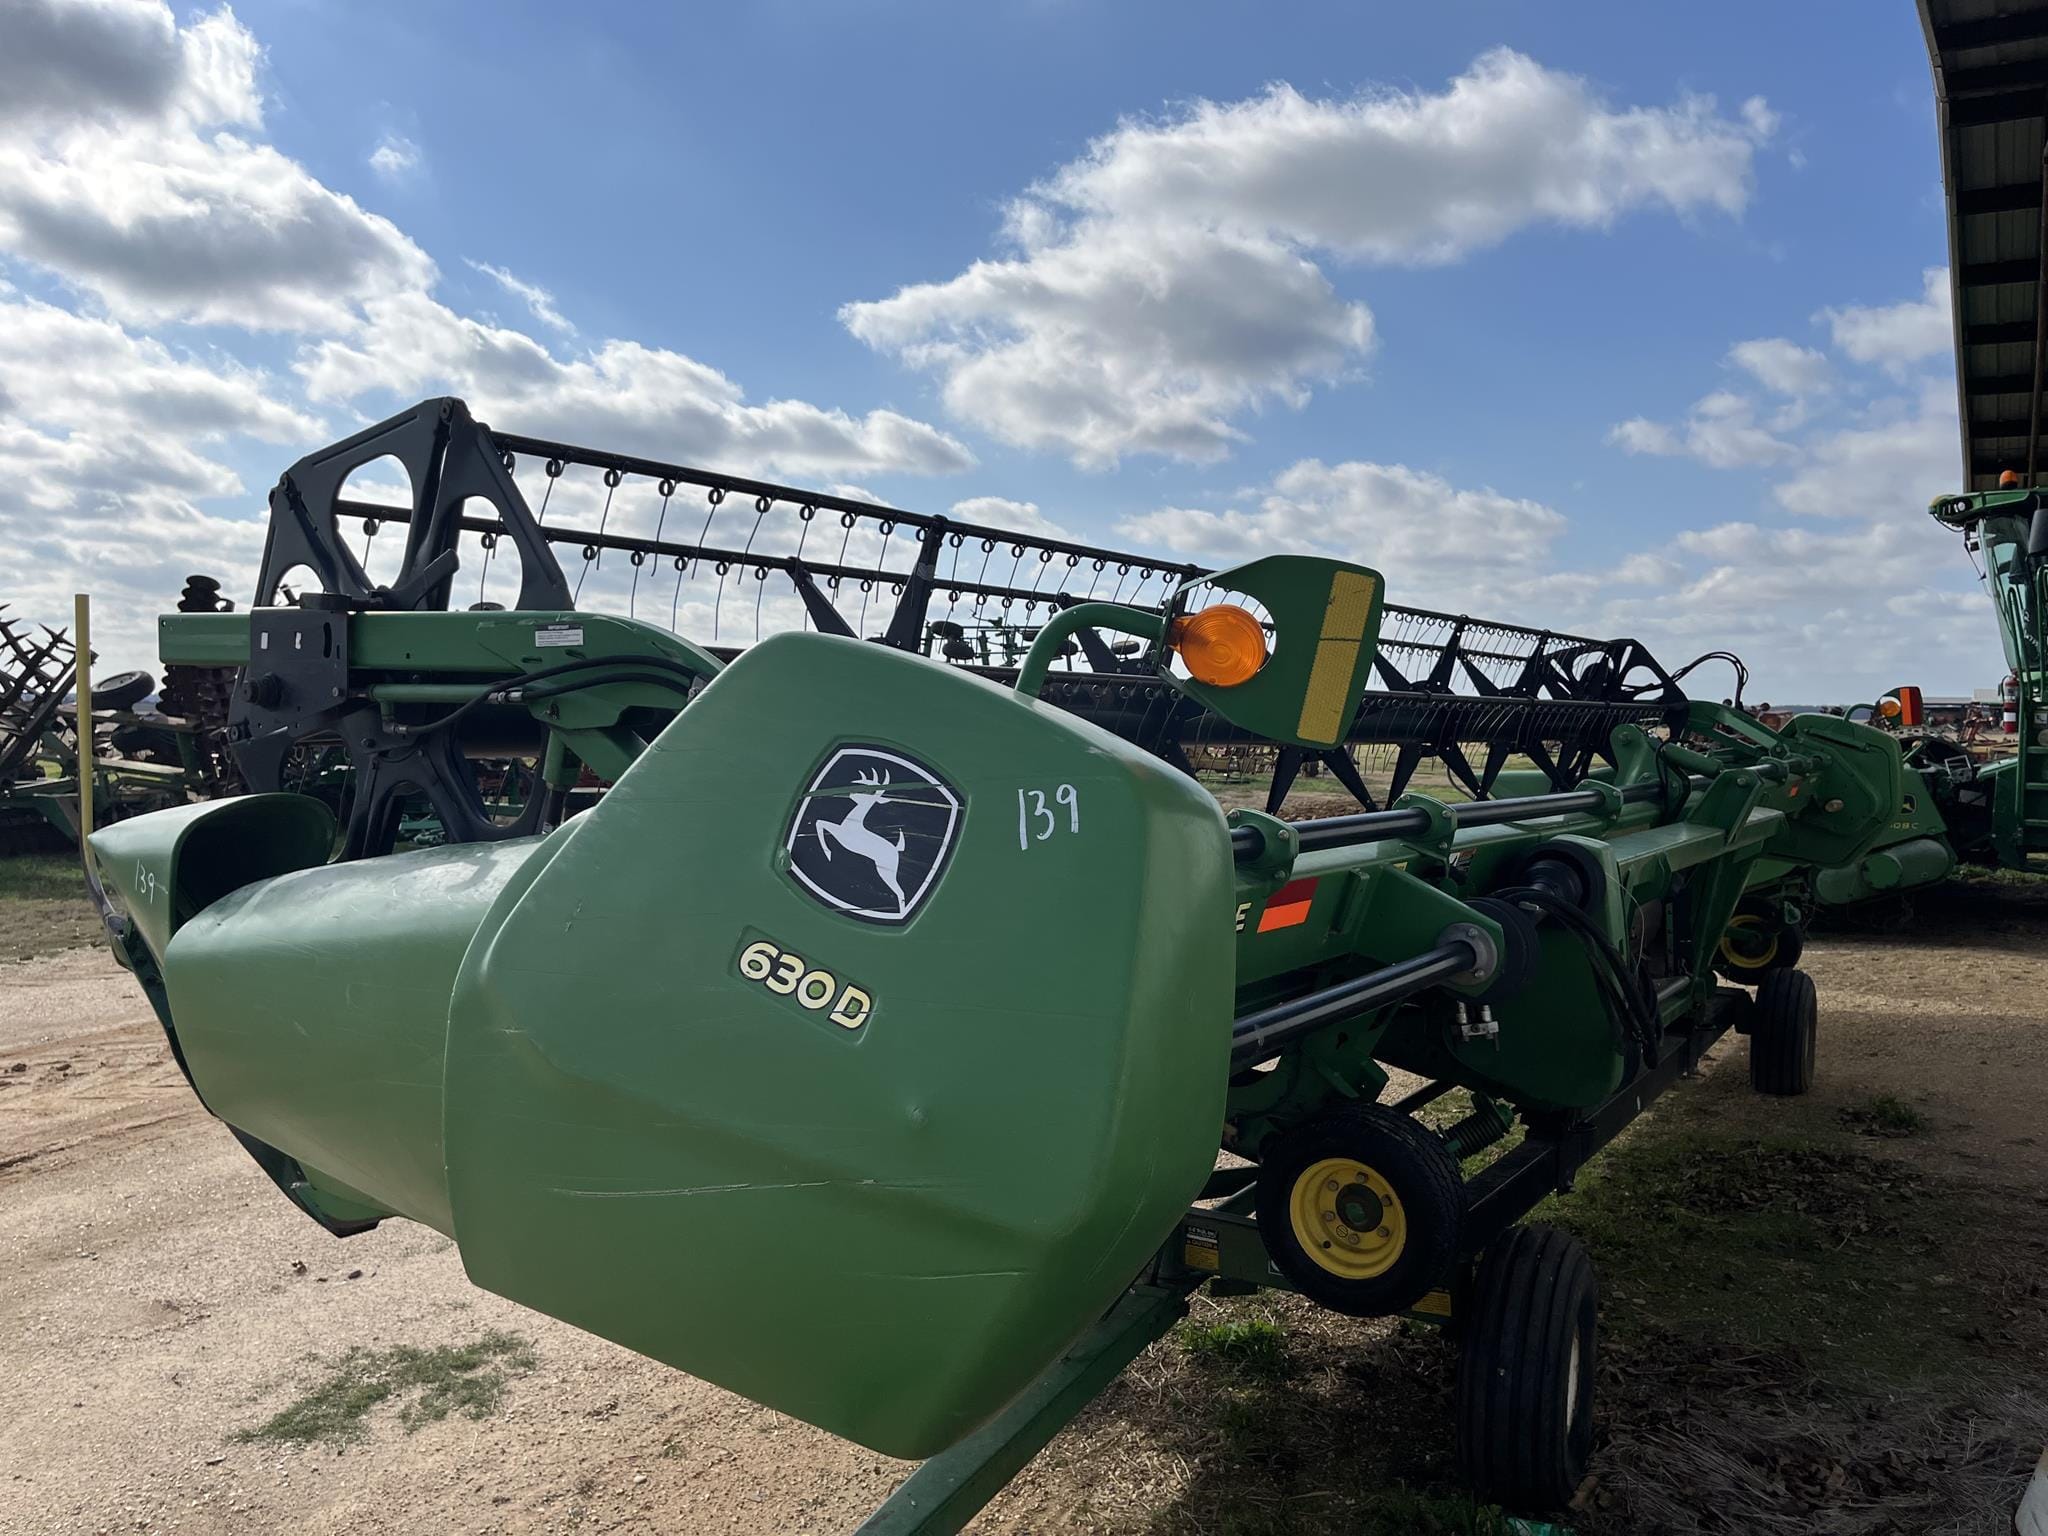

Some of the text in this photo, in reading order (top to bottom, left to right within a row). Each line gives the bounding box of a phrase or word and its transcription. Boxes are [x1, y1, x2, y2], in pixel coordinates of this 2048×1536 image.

[1017, 783, 1079, 851] 139
[134, 858, 155, 904] 139
[738, 941, 873, 1030] 630D
